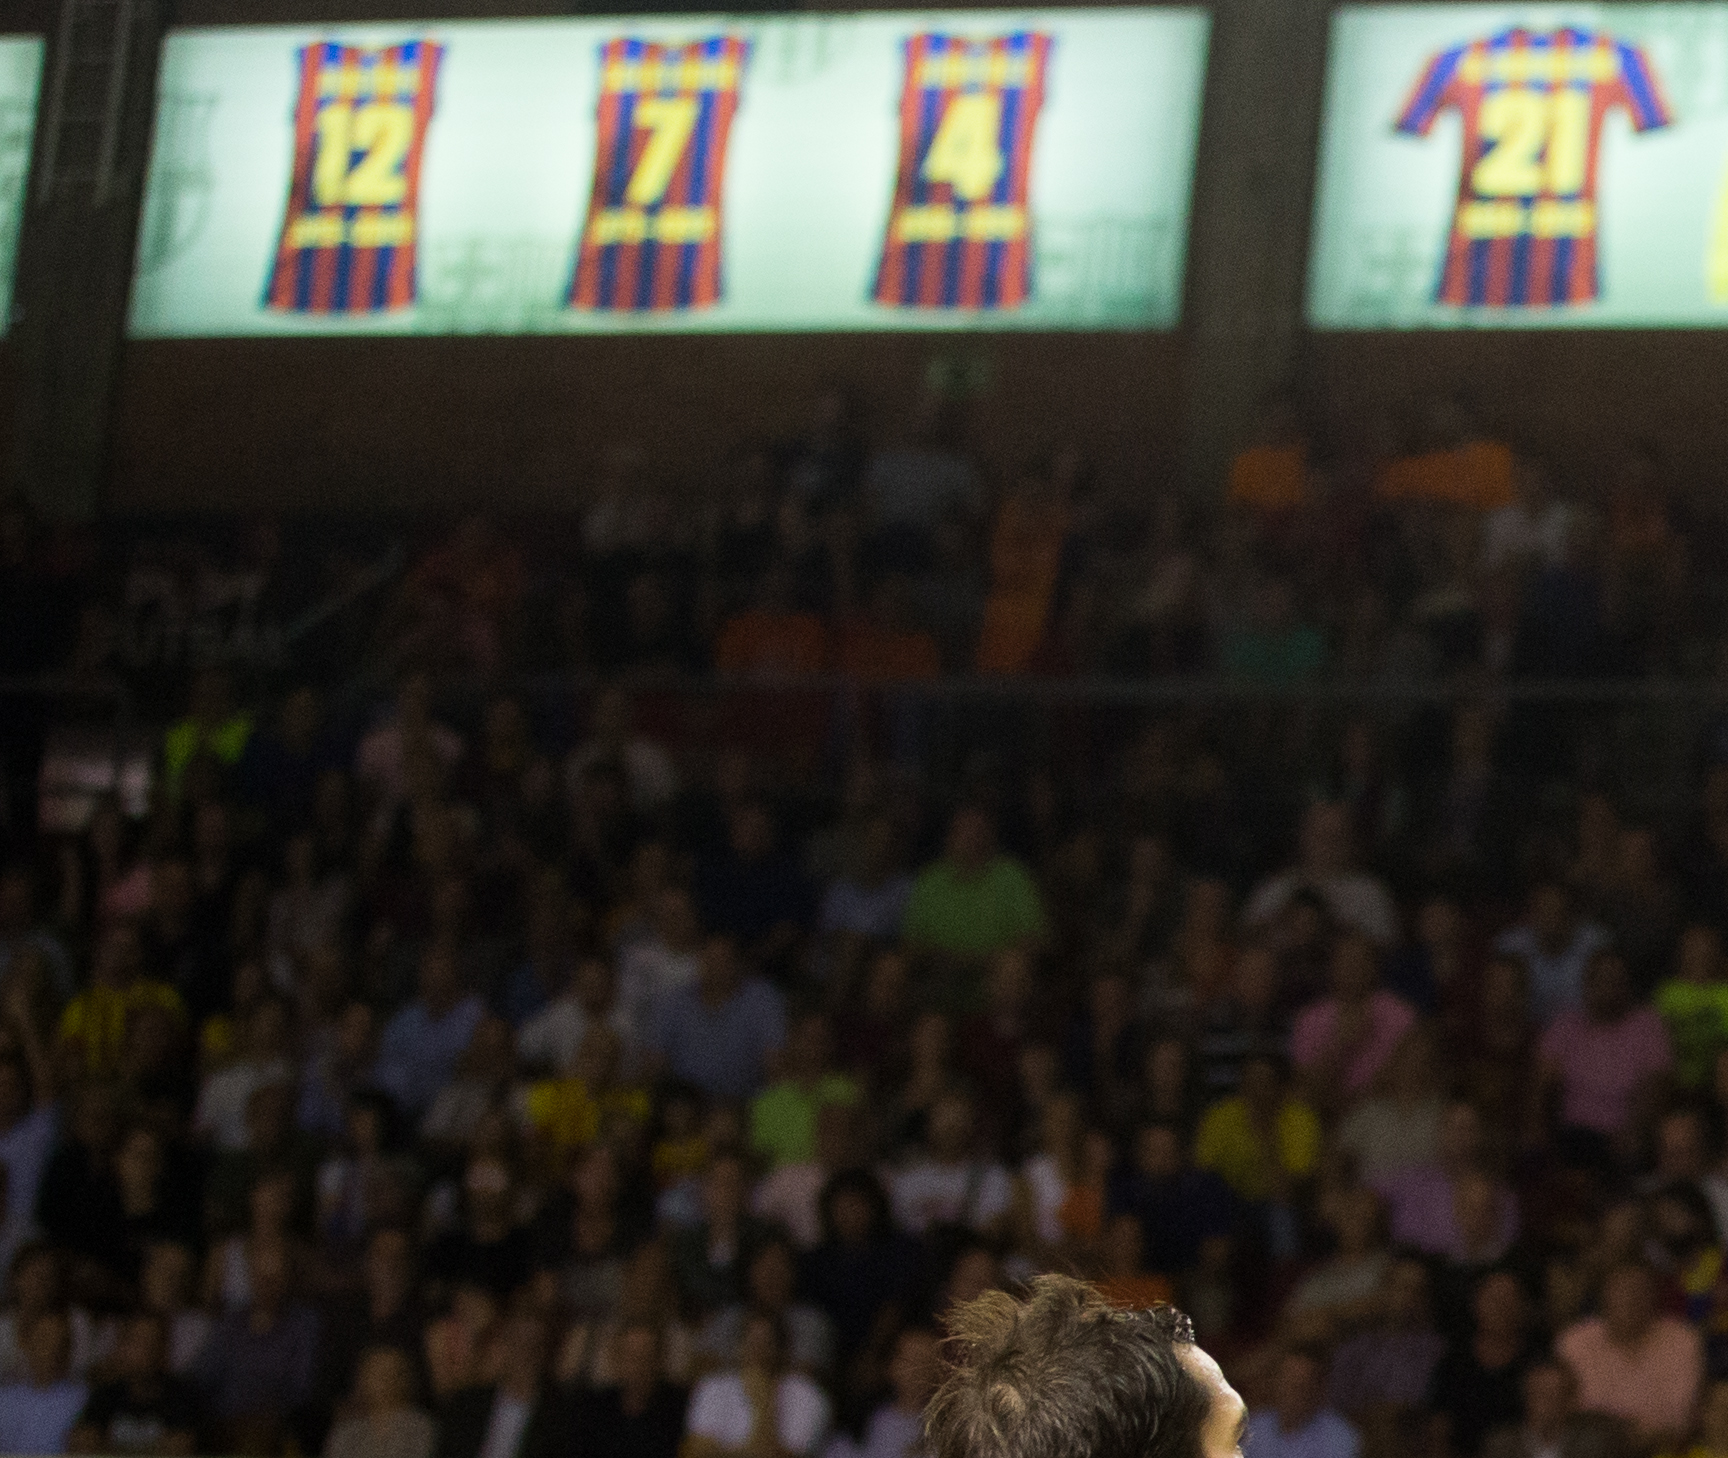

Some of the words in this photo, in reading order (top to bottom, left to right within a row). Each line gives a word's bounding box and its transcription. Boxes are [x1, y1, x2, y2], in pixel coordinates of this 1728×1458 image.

[313, 103, 415, 207] 12
[626, 99, 702, 205] 7
[921, 98, 1005, 202] 4
[1471, 88, 1592, 198] 21
